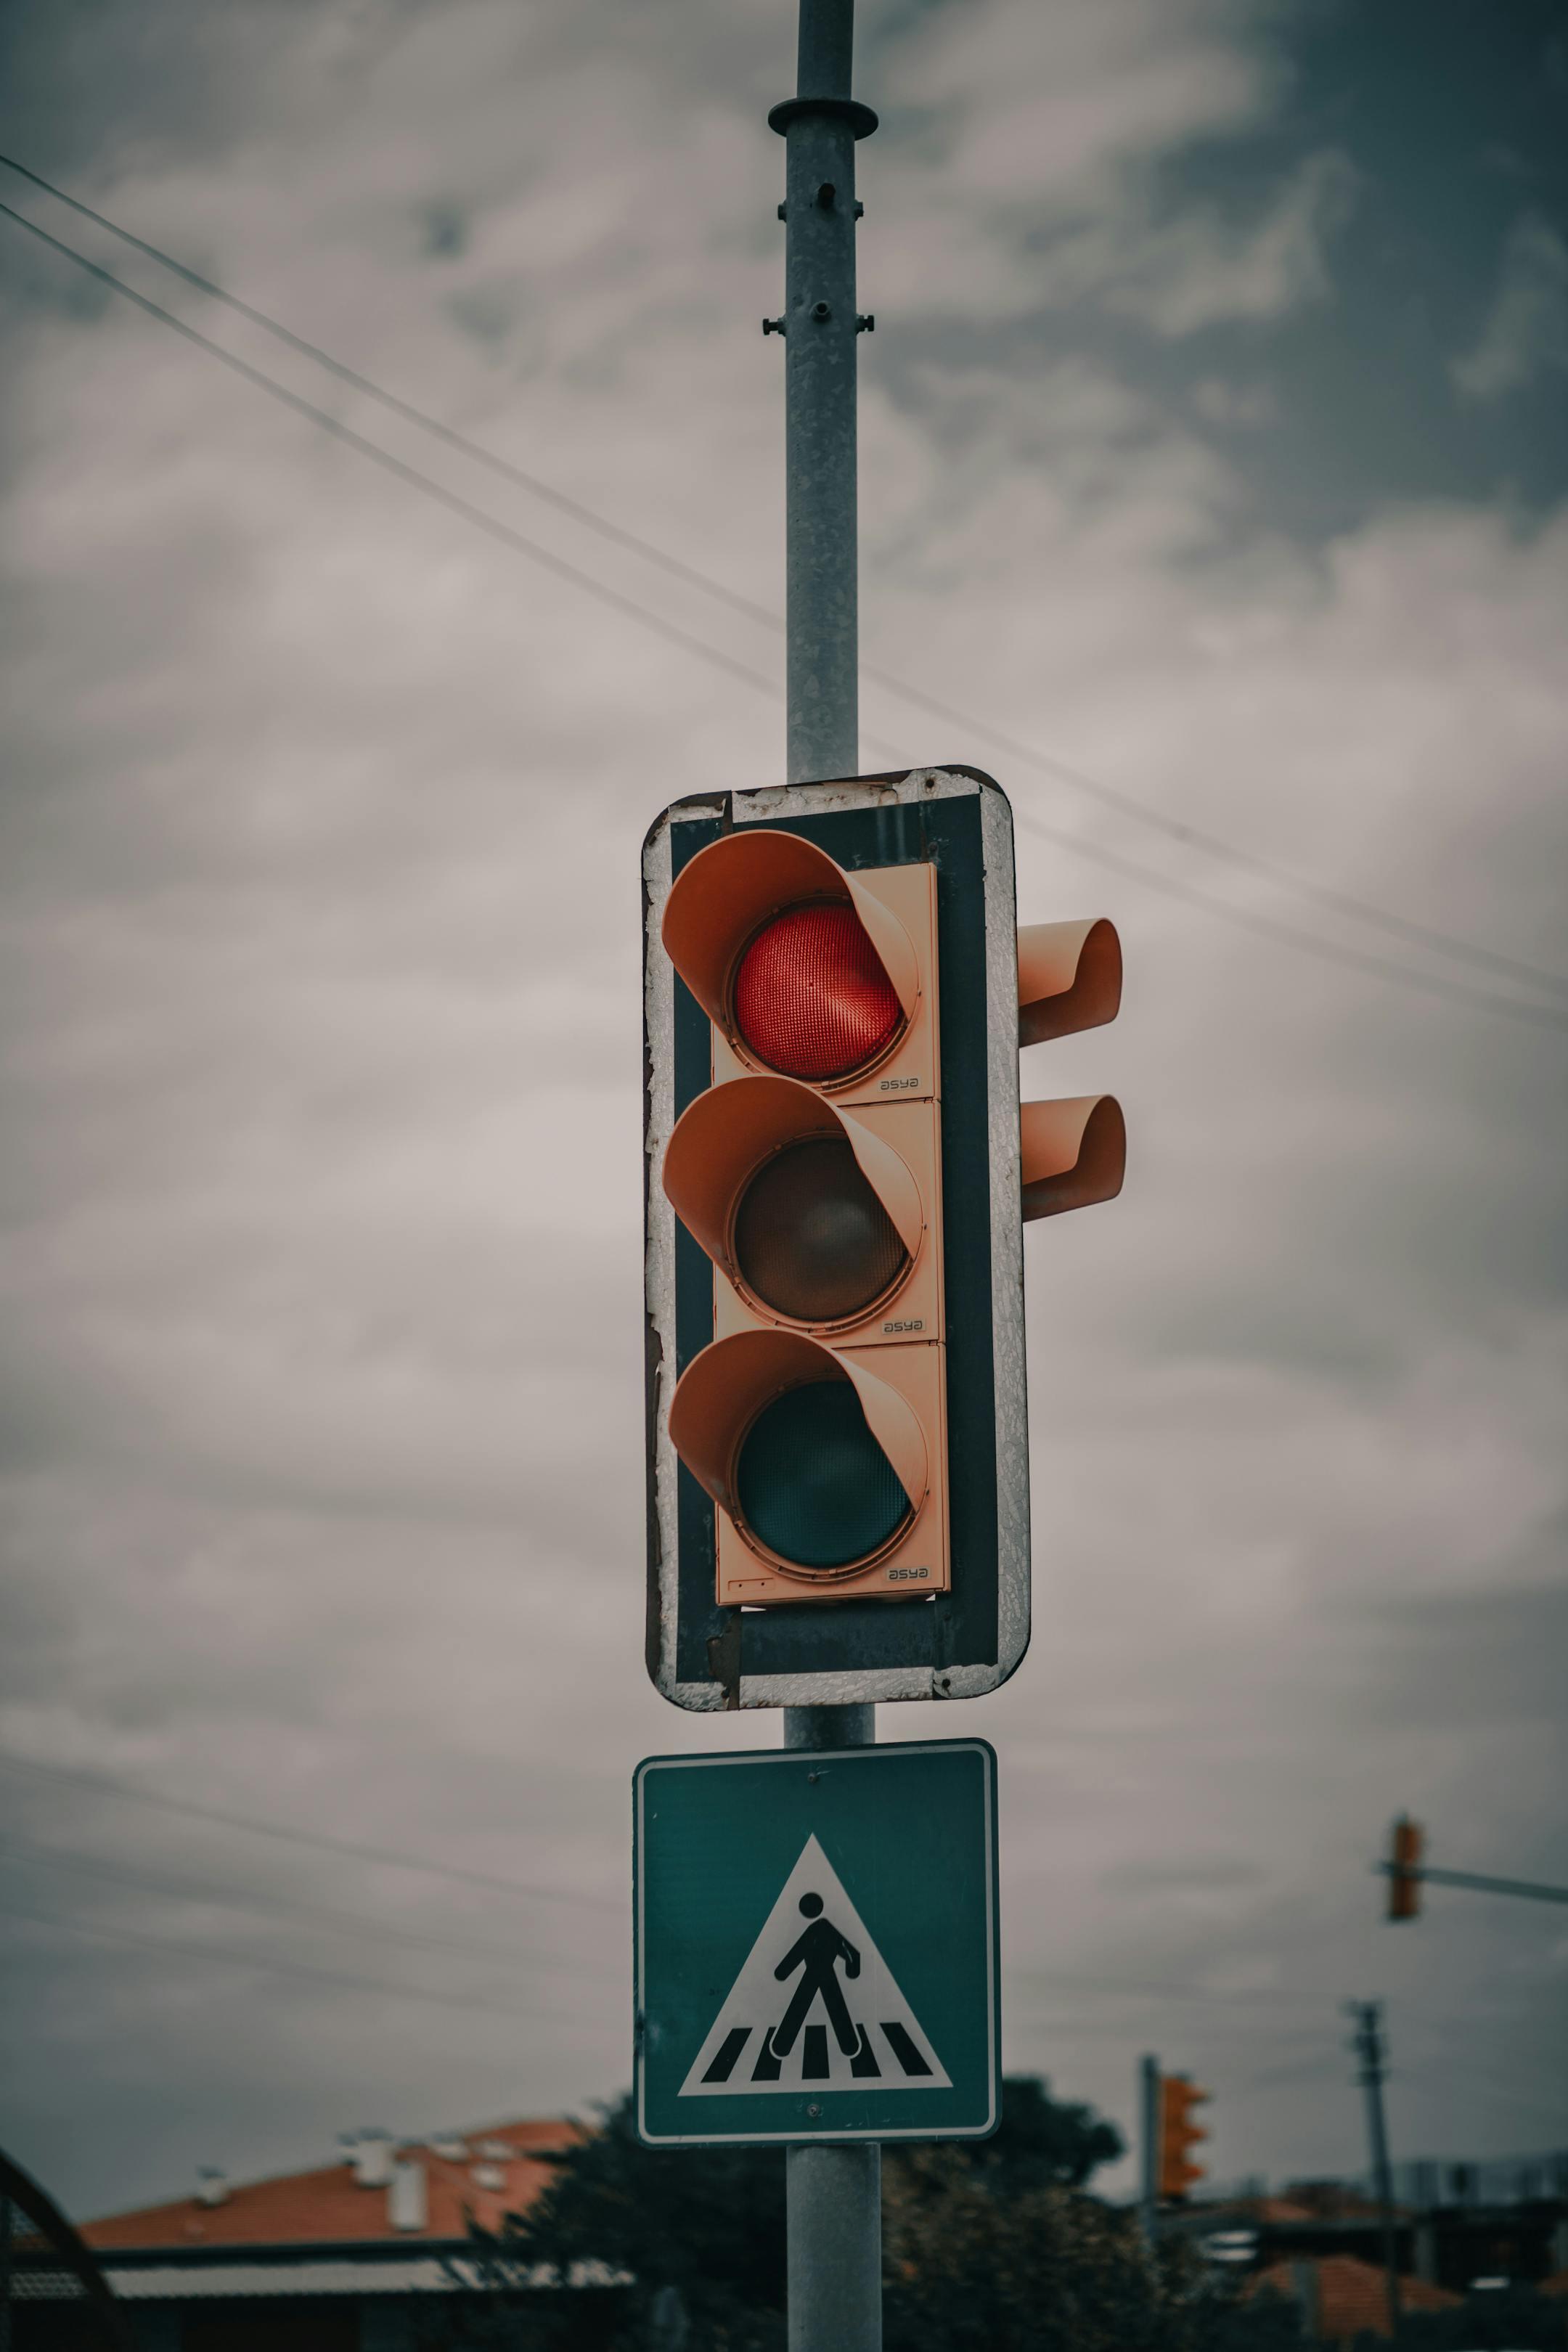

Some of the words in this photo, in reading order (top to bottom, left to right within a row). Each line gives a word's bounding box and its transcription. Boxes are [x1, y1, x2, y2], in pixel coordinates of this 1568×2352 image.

[881, 1078, 918, 1090] asya
[884, 1320, 923, 1333] asya
[889, 1568, 928, 1580] asya
